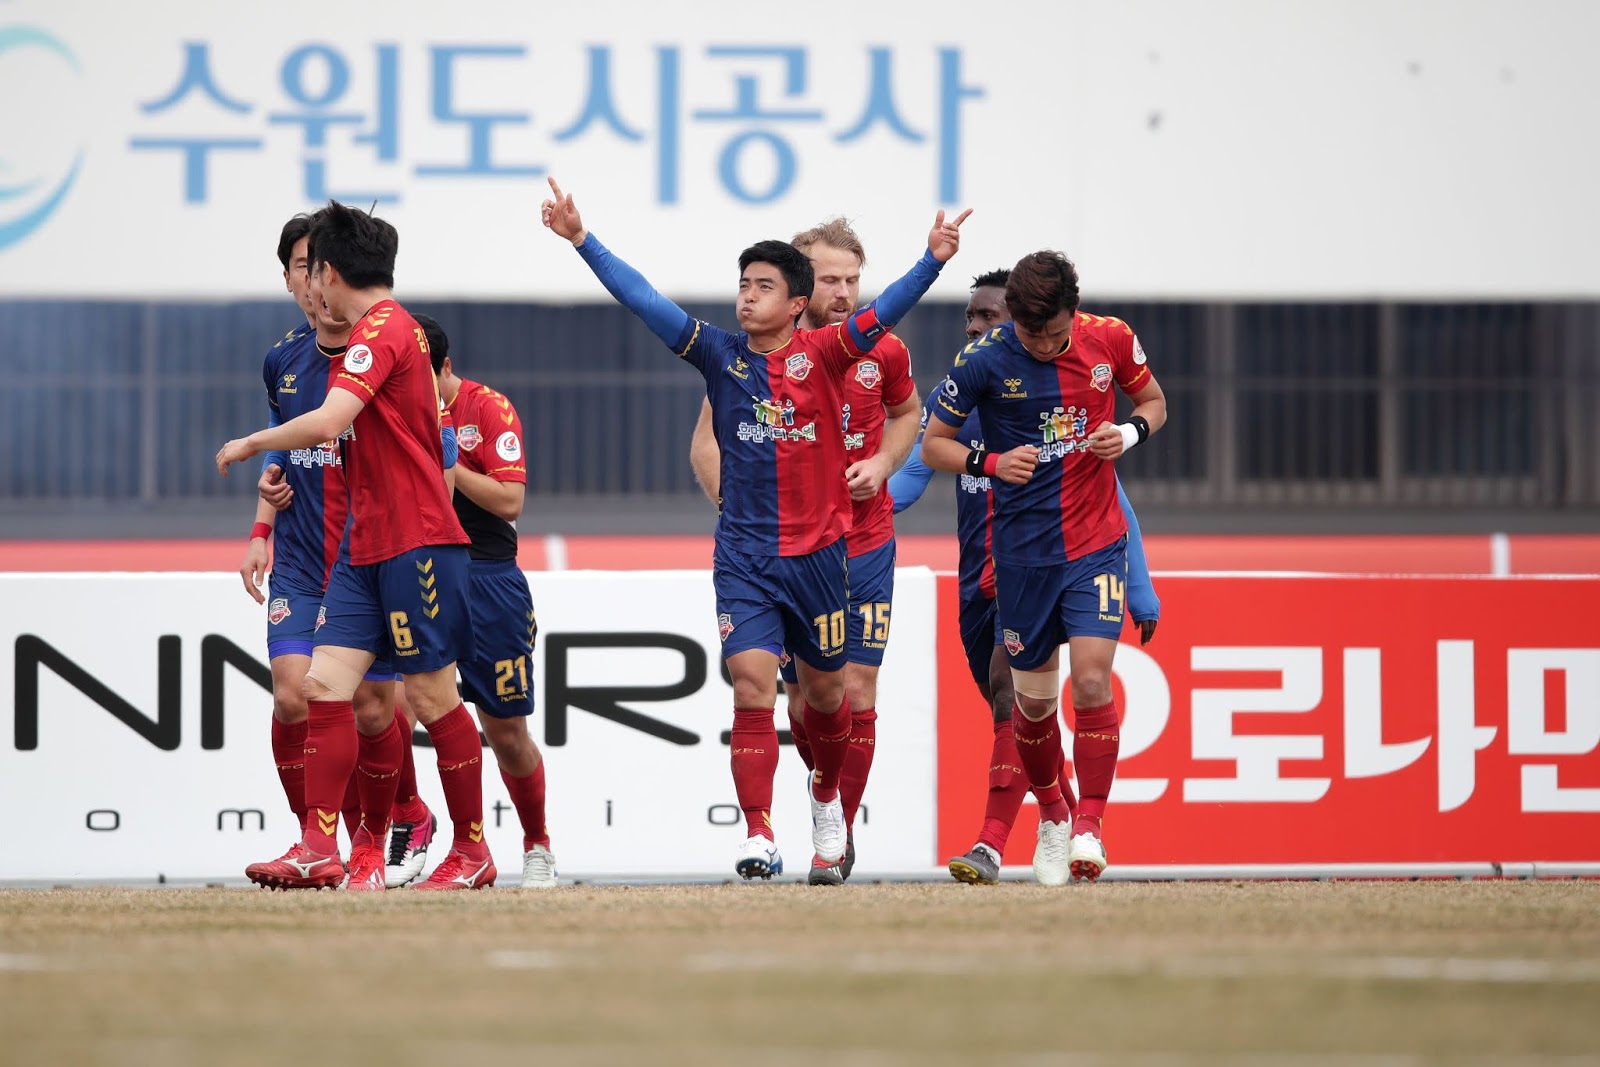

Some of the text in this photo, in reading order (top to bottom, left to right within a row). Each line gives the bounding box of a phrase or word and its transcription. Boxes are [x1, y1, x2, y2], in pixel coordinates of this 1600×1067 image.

[128, 40, 987, 206] 수원도시공사
[1001, 390, 1028, 399] hummel
[788, 421, 816, 442] 수원
[1093, 573, 1124, 614] 14
[389, 610, 414, 649] 6
[813, 608, 846, 650] 10
[859, 602, 891, 641] 15
[395, 647, 420, 657] hummel
[494, 655, 528, 696] 21
[1078, 732, 1119, 742] SWFC
